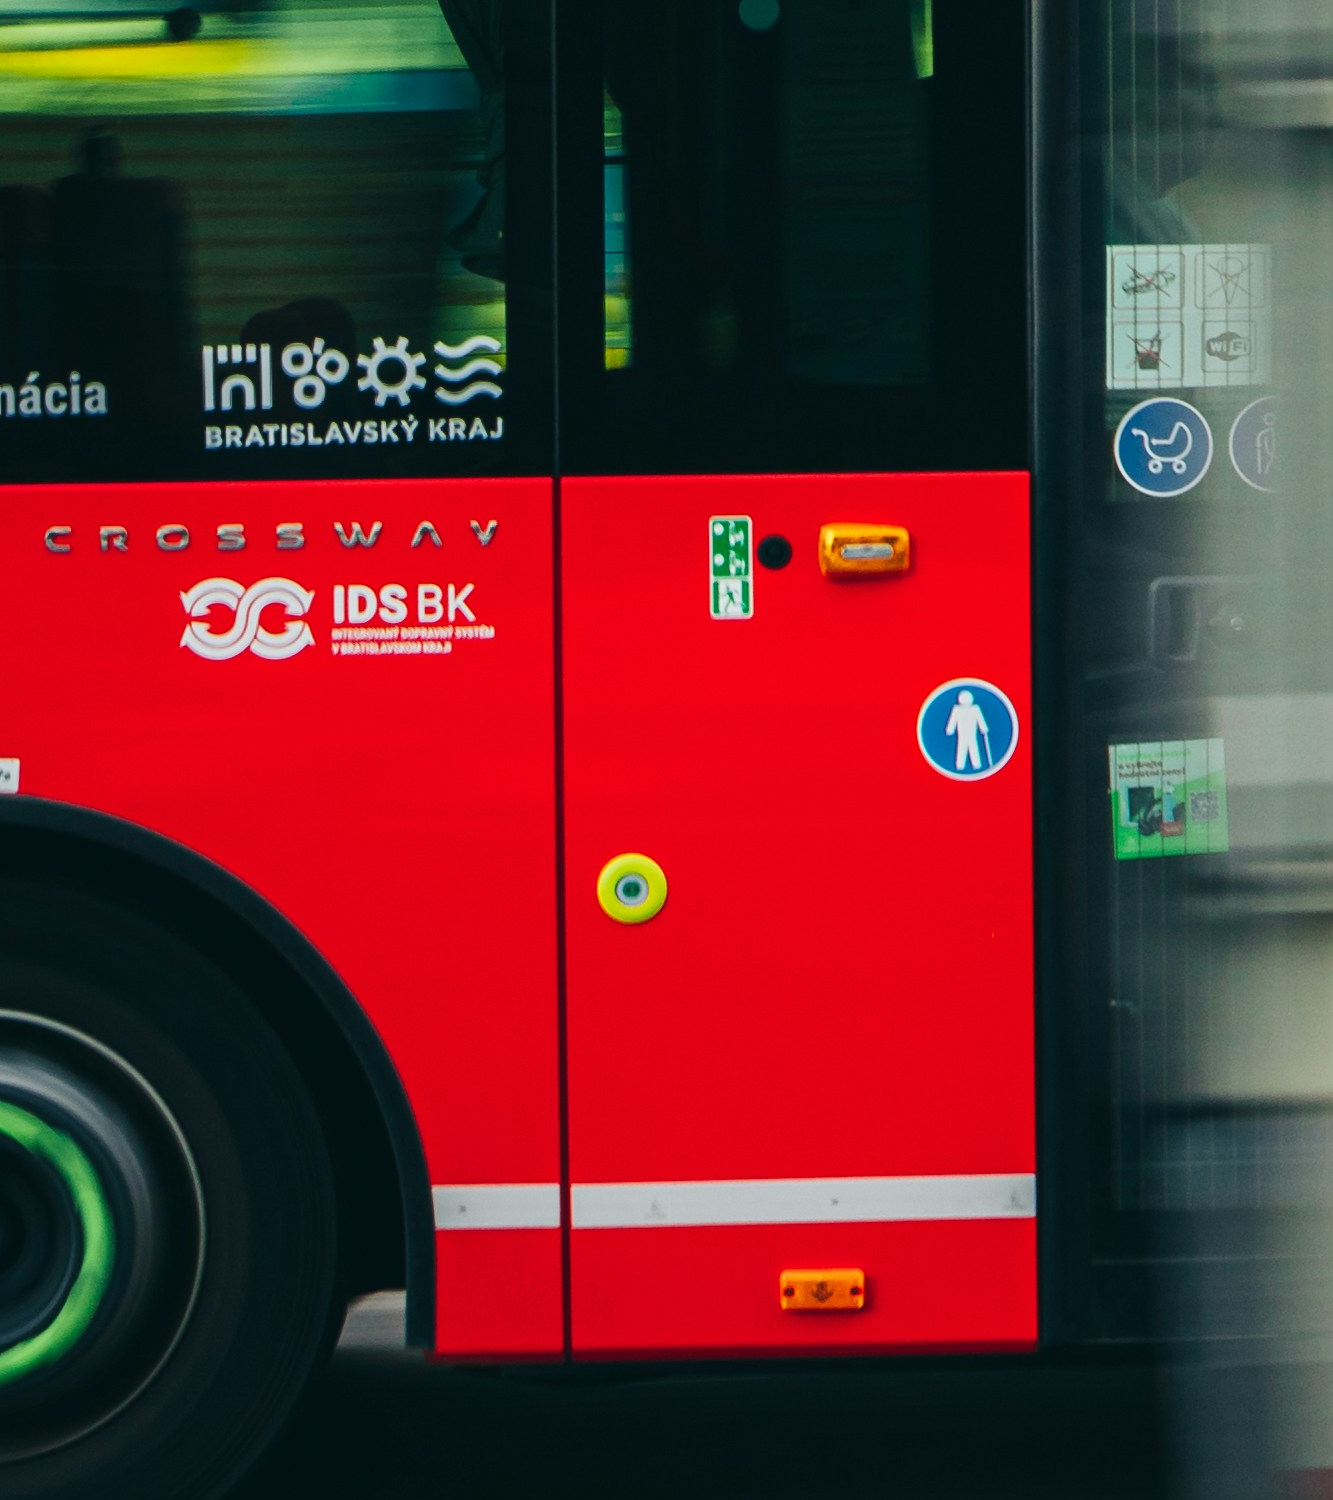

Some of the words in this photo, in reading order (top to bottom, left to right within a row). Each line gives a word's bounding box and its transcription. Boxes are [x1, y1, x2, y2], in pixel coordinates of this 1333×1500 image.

[205, 413, 419, 450] BRATISLAVSKÝ
[429, 416, 504, 441] KRAJ
[44, 519, 498, 553] CROSSWAY
[333, 583, 408, 624] IDS
[417, 583, 476, 623] BK
